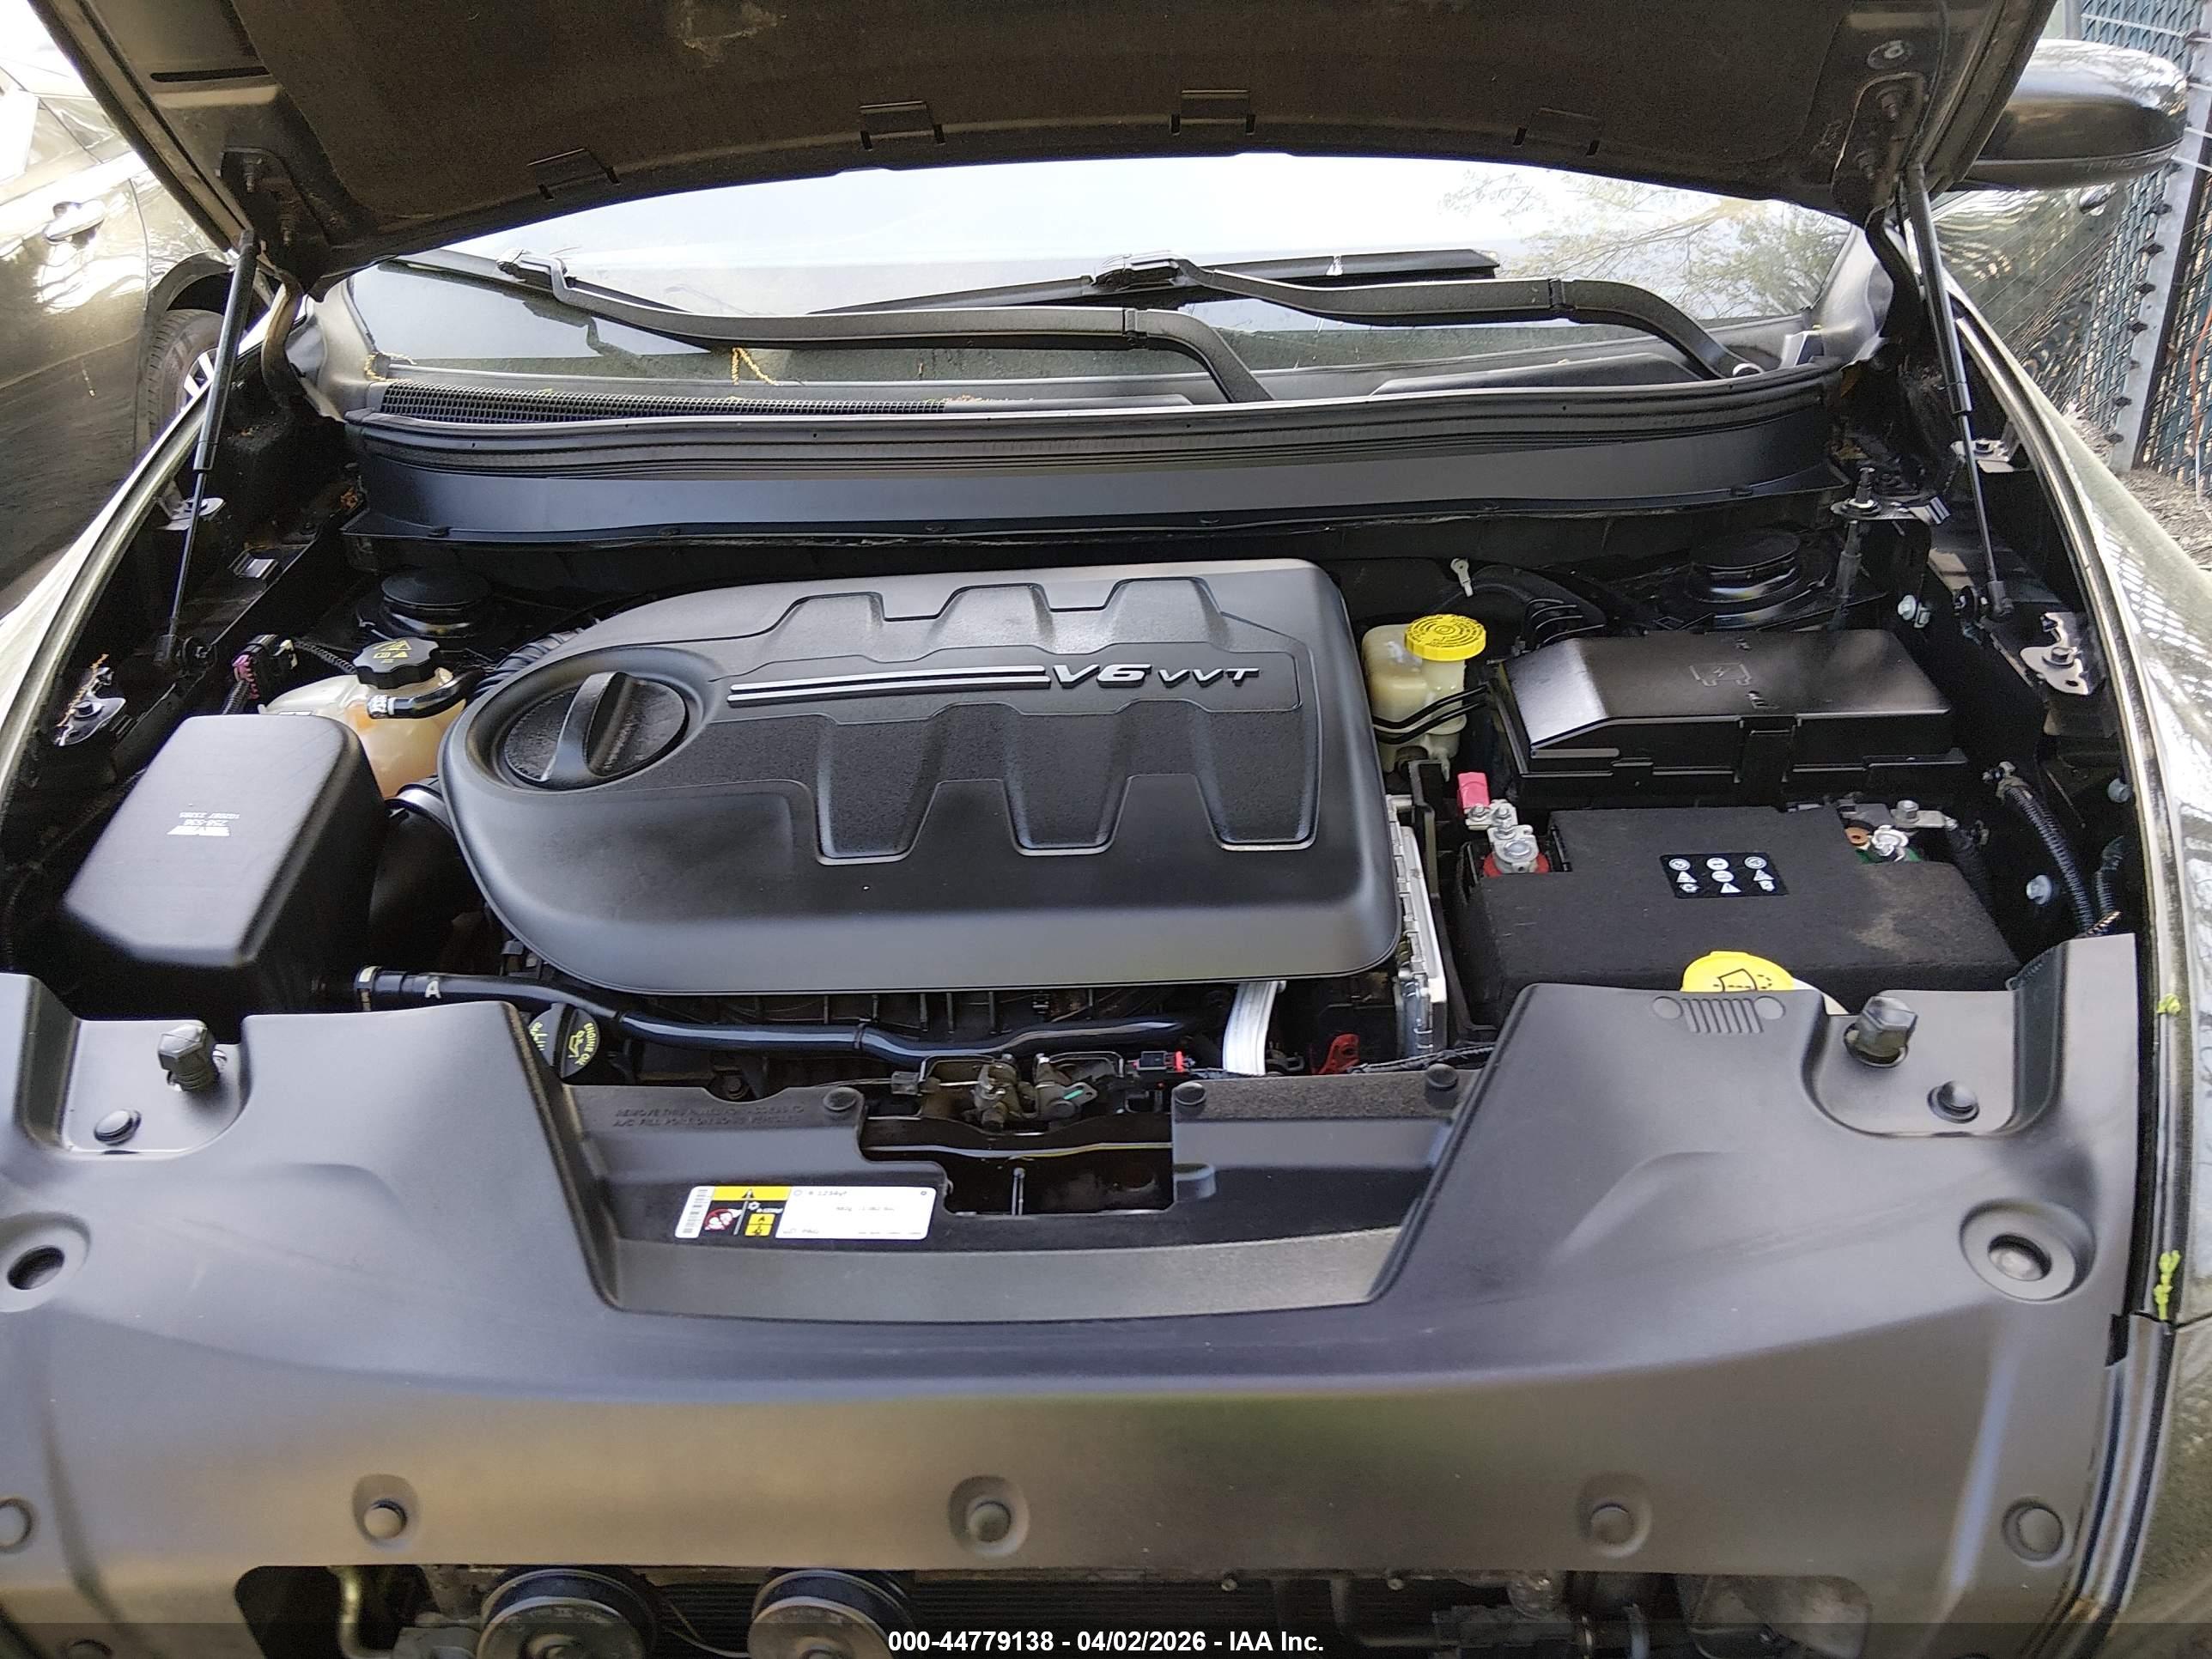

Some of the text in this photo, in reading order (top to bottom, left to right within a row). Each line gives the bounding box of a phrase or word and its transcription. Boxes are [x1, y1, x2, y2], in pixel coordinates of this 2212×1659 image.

[1053, 664, 1260, 688] V6 VVT
[425, 981, 442, 999] A
